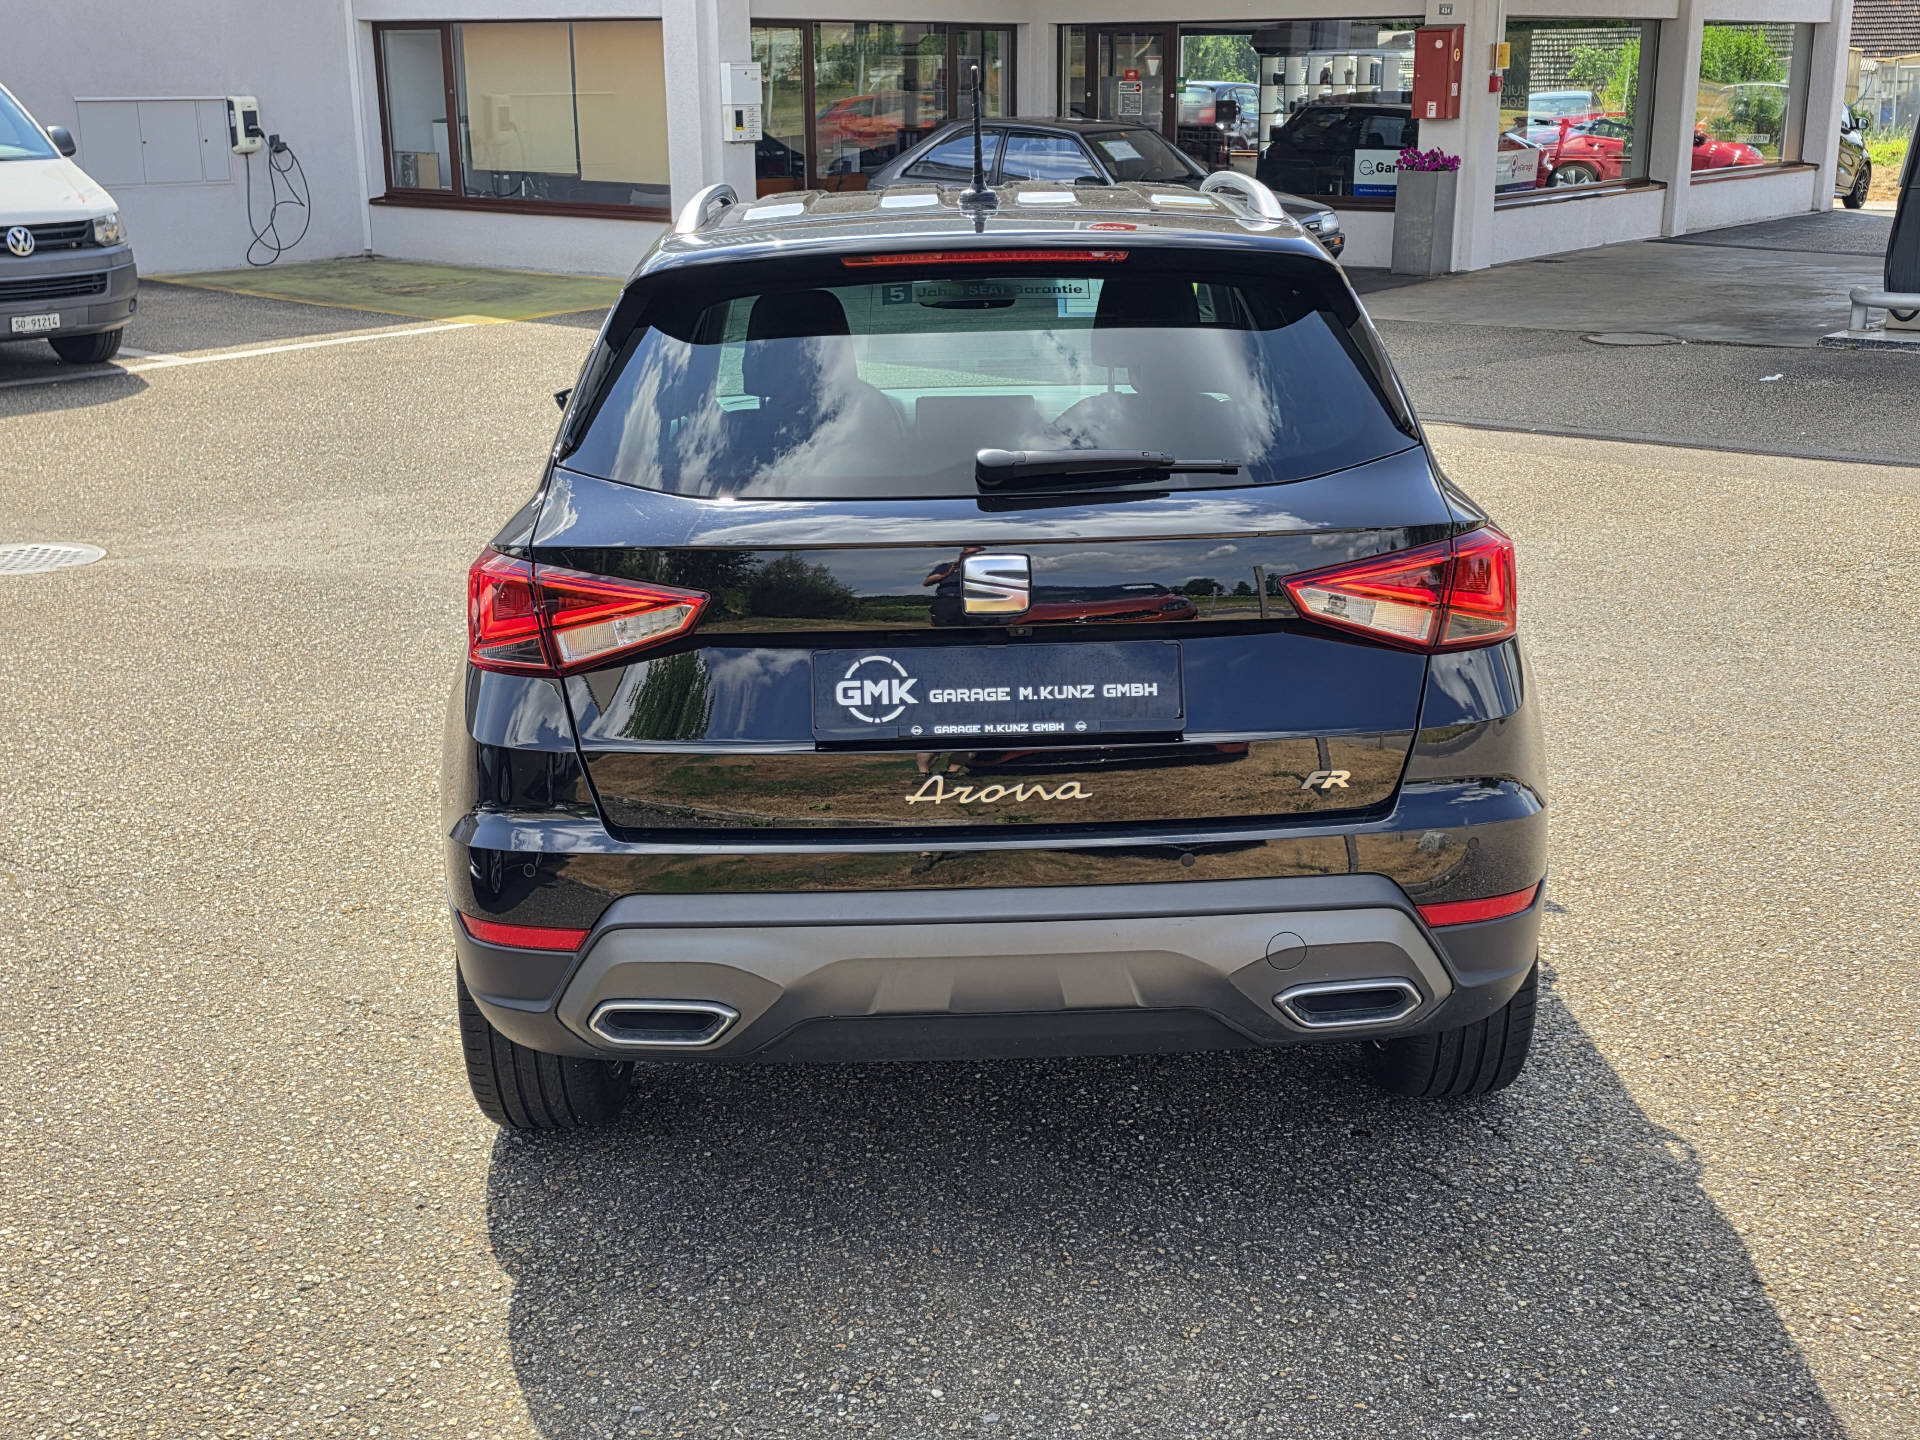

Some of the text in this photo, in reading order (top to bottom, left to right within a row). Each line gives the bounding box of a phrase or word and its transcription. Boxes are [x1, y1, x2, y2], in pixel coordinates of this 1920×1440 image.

[1428, 104, 1435, 116] F
[889, 286, 905, 301] 5
[835, 678, 920, 706] GMK
[929, 682, 1158, 703] GARAGE M.KUNZ GMBH
[934, 724, 981, 734] GARAGE
[984, 723, 1029, 733] M.KUNZ
[1032, 722, 1065, 732] GMBH
[905, 775, 1093, 805] Arona
[1300, 770, 1351, 790] FR
